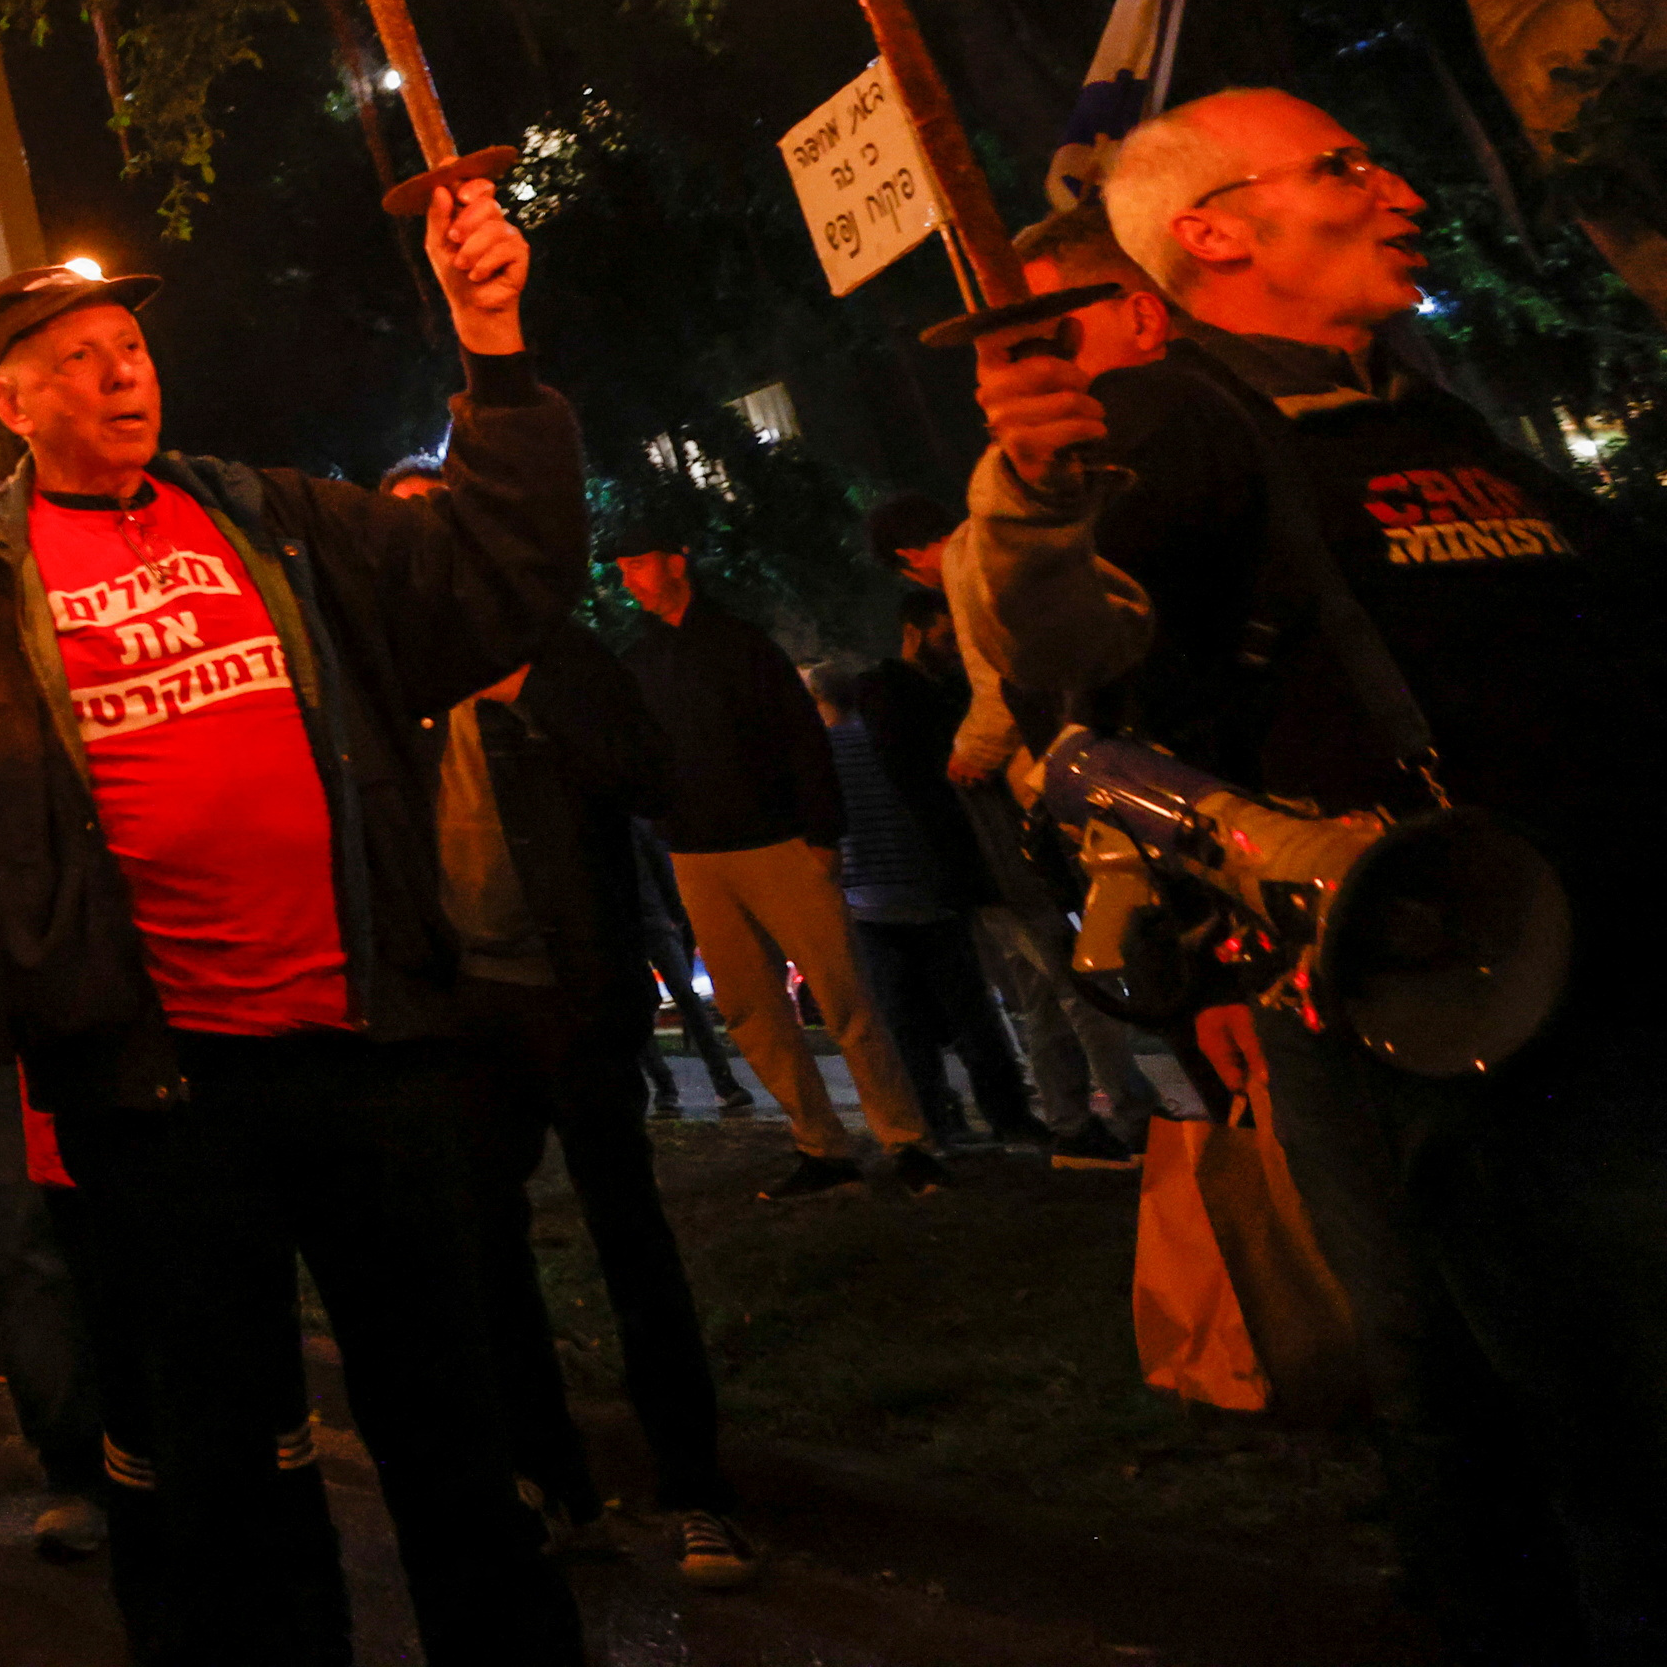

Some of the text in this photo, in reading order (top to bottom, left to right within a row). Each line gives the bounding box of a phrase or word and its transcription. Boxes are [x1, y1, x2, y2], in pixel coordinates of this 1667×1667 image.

[823, 210, 862, 260] נפש
[114, 610, 205, 666] את
[73, 643, 286, 728] דמוקרטי
